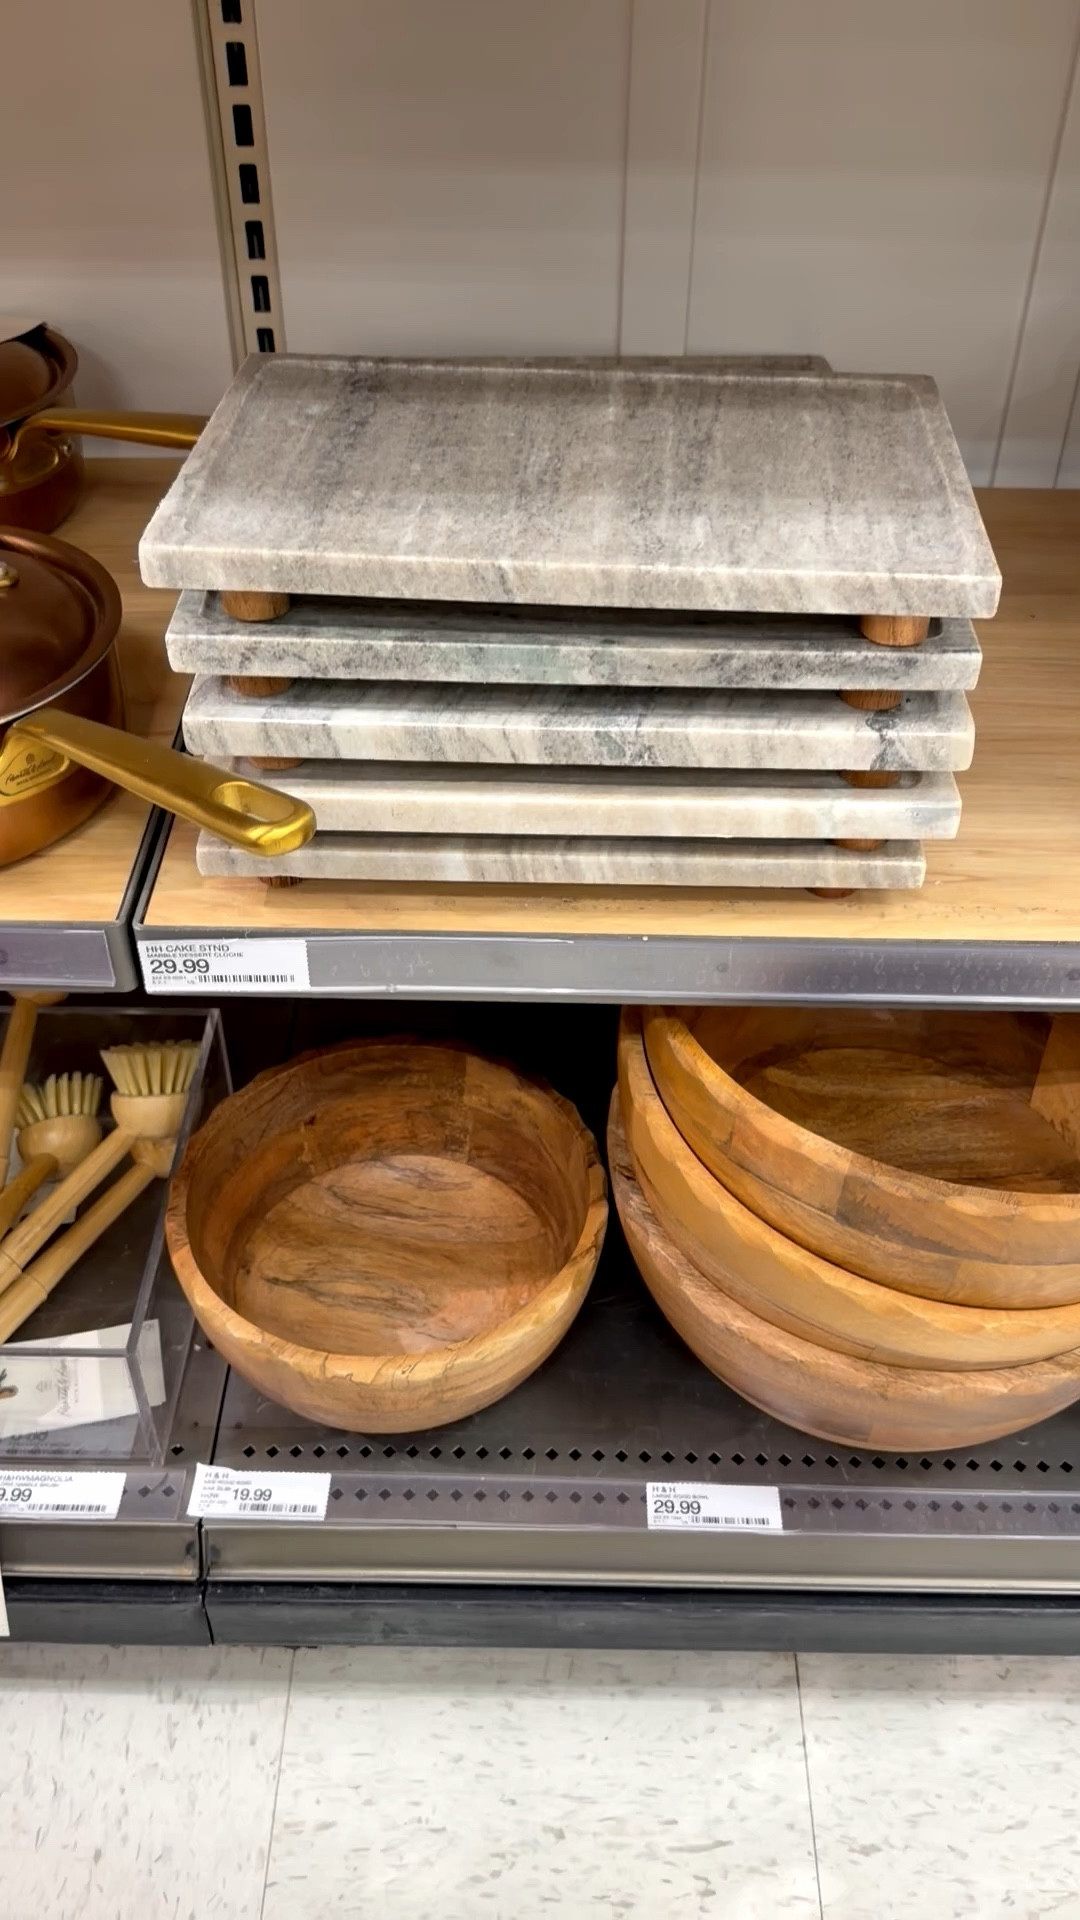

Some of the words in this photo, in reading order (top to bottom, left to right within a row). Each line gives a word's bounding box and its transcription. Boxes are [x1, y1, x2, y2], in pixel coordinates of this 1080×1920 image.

[165, 944, 195, 952] CAKE
[198, 943, 230, 952] STND
[150, 958, 210, 974] 29.99
[233, 1488, 272, 1502] 19.99
[653, 1499, 701, 1515] 29.99
